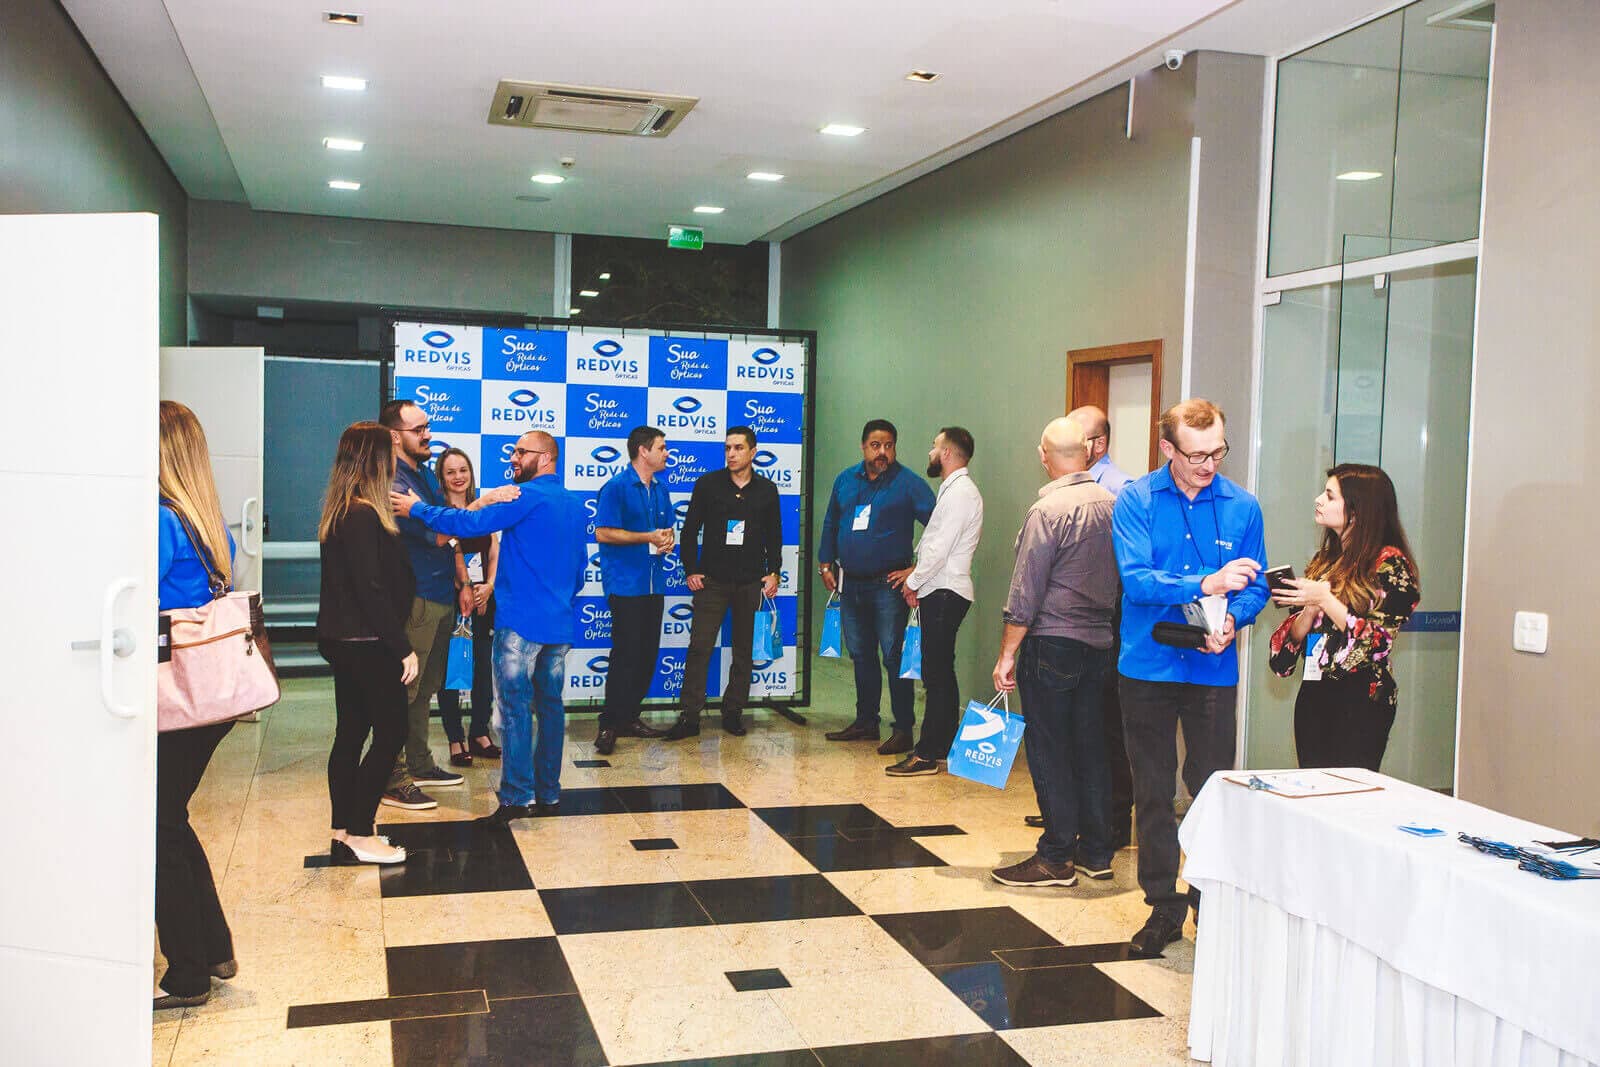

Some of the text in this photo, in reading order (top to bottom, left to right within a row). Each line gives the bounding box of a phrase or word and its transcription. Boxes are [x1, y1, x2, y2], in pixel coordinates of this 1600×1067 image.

[501, 335, 537, 354] Sua
[405, 350, 471, 364] REDVIS
[667, 344, 700, 363] Sua
[506, 357, 540, 372] Ópticas
[577, 358, 638, 372] REDVIS
[670, 366, 702, 380] Ópticas
[737, 366, 794, 380] REDVIS
[414, 385, 450, 405] Sua
[584, 393, 618, 412] Sua
[743, 399, 776, 418] Sua
[427, 412, 453, 422] pticas
[492, 408, 555, 422] REDVIS
[657, 414, 716, 428] REDVIS
[588, 416, 621, 429] Ópticas
[665, 448, 697, 467] Sua
[575, 465, 624, 477] REDV
[668, 470, 699, 484] Óptica
[756, 469, 791, 481] DVIS
[580, 604, 612, 623] Sua
[660, 656, 686, 674] Su
[751, 672, 786, 684] DVIS
[965, 749, 1002, 767] REDVIS
